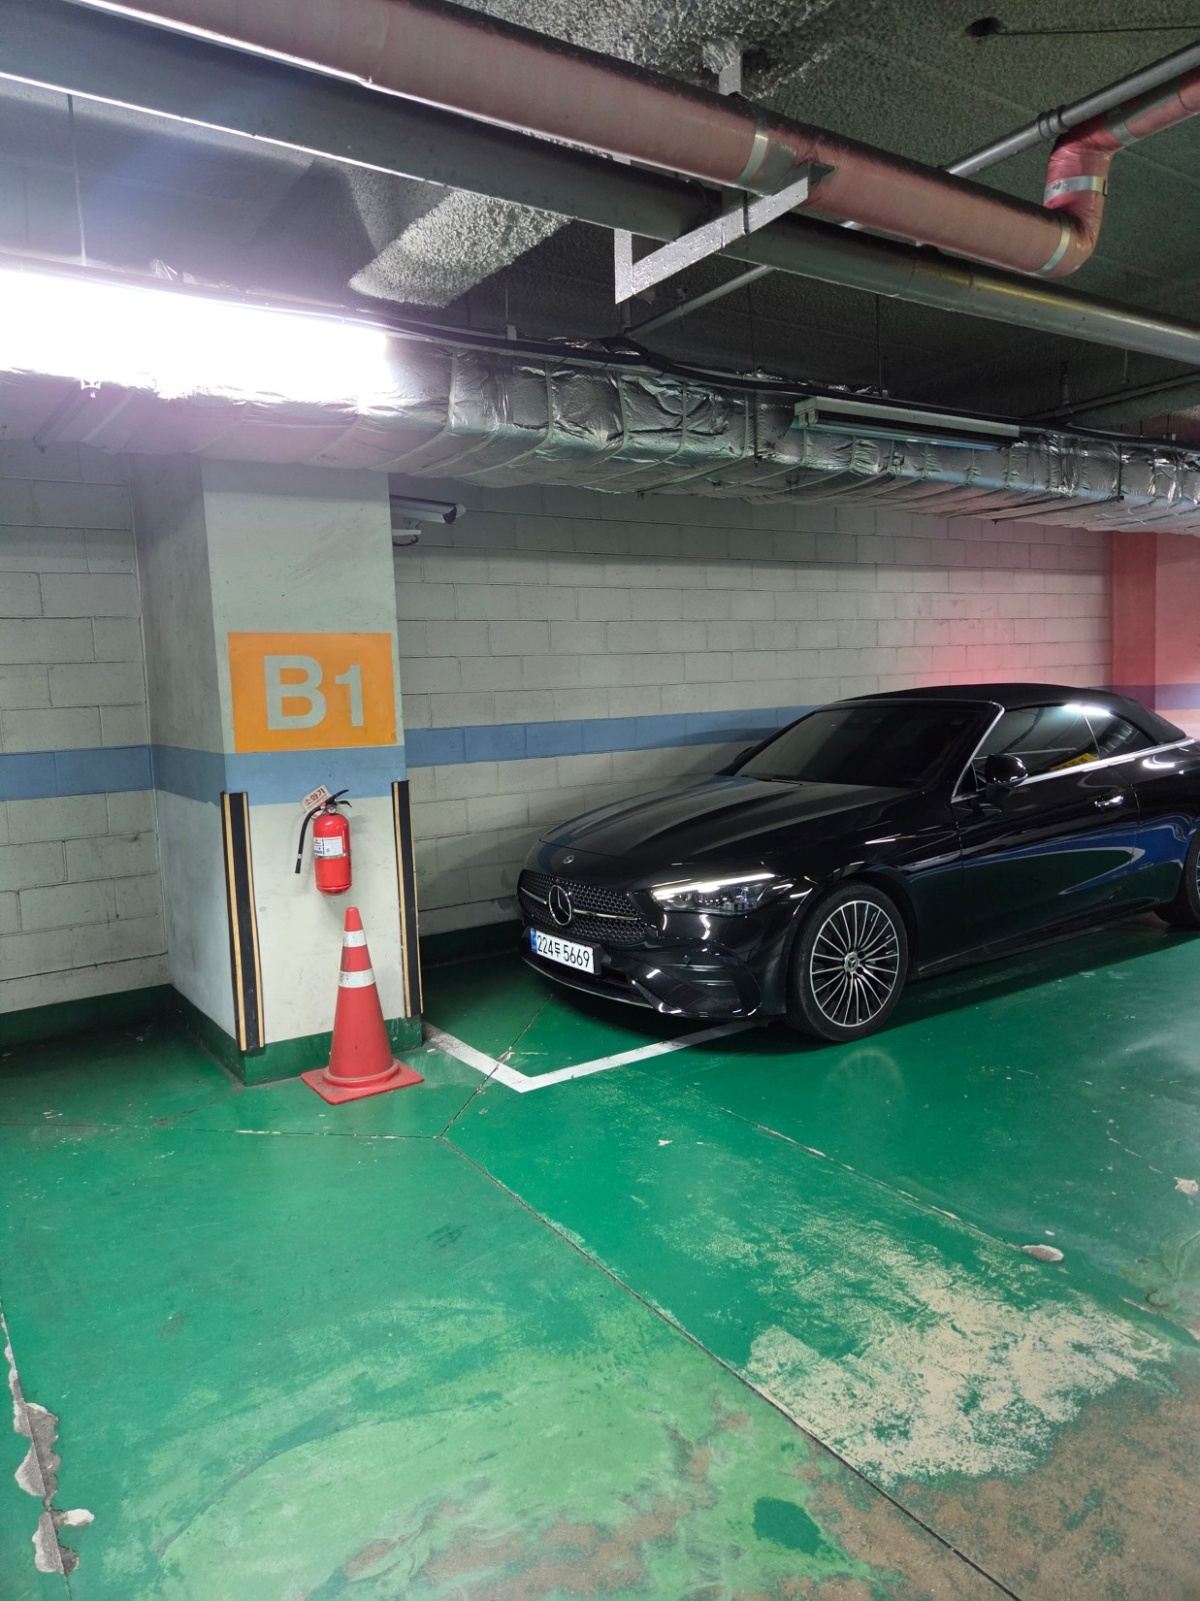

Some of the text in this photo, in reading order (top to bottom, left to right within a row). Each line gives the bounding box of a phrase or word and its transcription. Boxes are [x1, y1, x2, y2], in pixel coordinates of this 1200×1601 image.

[263, 654, 365, 730] B1
[304, 787, 326, 807] 소화기
[563, 944, 590, 968] 5669
